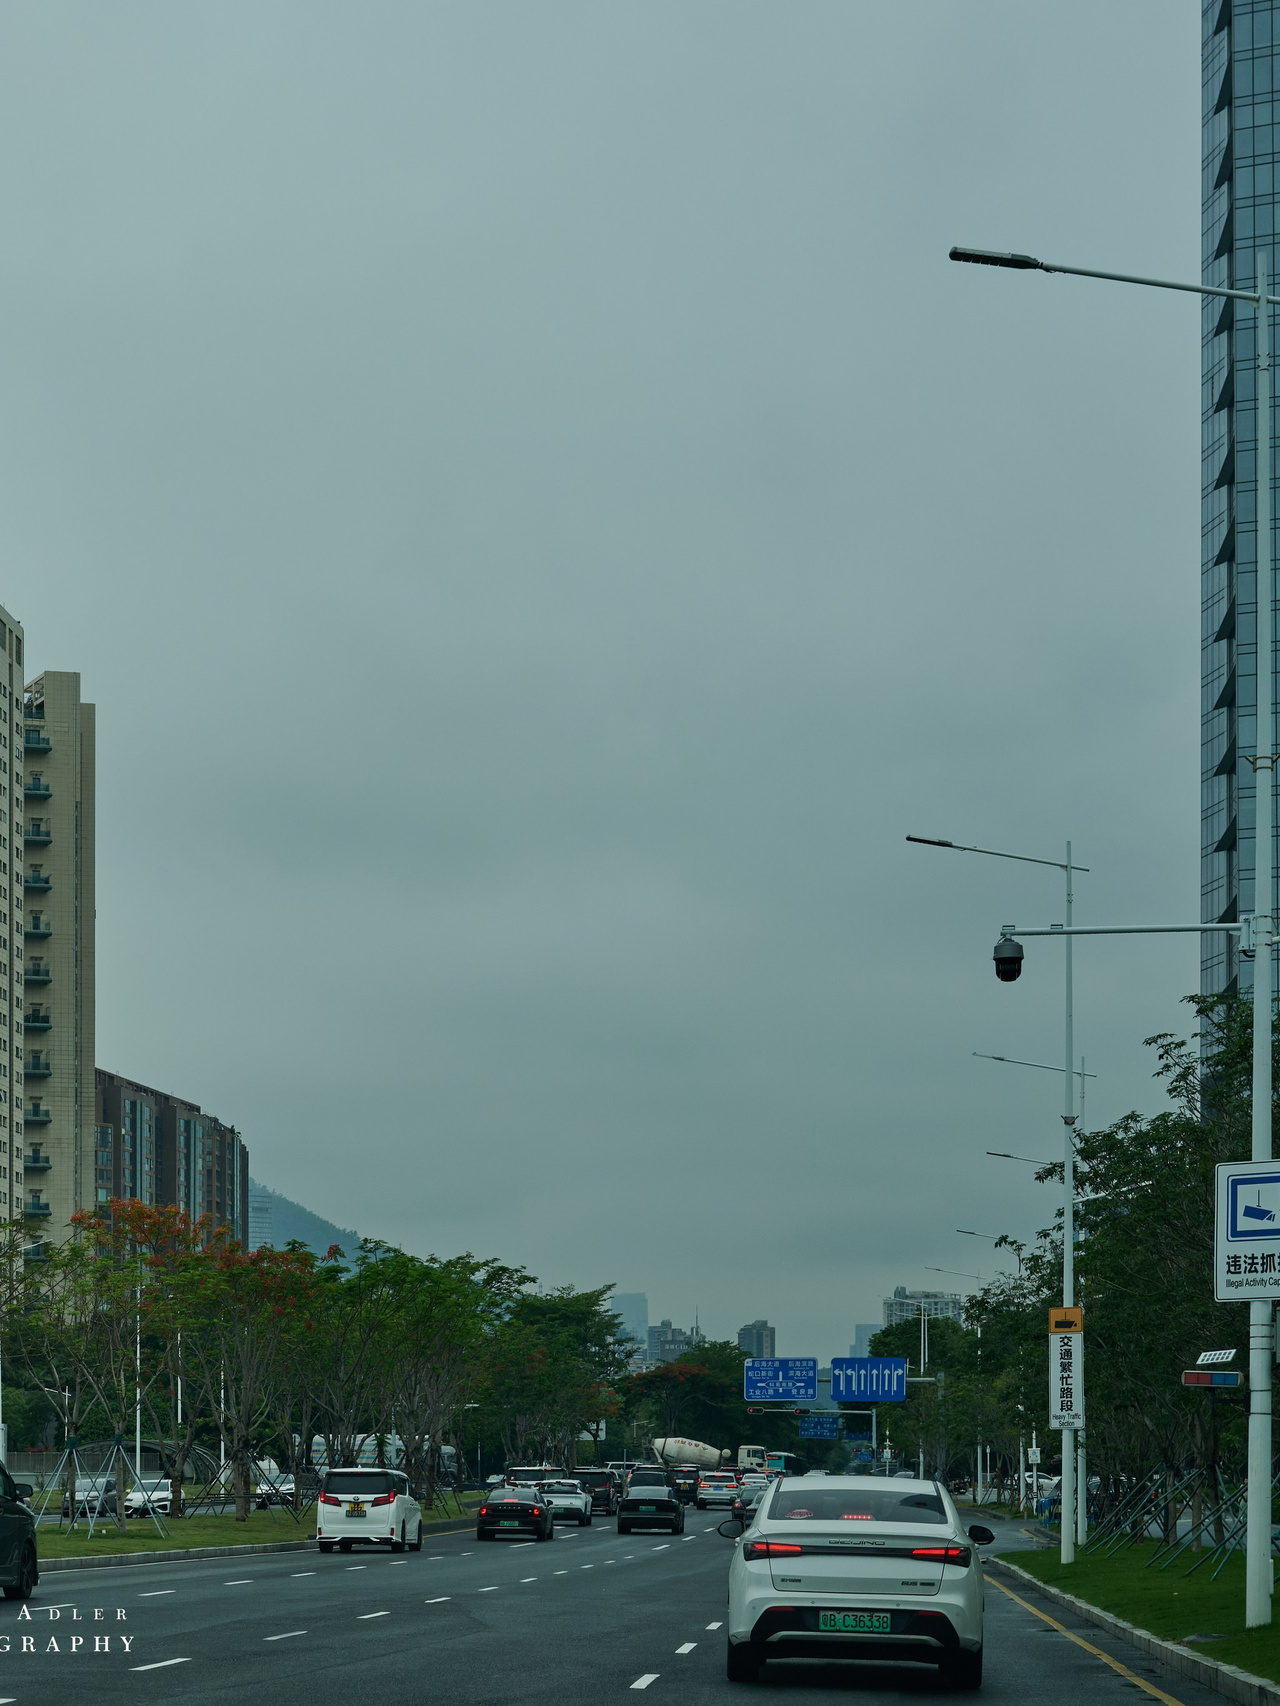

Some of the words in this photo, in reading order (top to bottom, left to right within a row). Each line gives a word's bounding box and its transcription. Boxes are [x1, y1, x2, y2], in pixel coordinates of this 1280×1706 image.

[1225, 1252, 1280, 1275] 违法抓
[1225, 1276, 1244, 1289] Illegal
[1245, 1275, 1267, 1288] Activity
[1059, 1335, 1074, 1412] 交通繁忙路段
